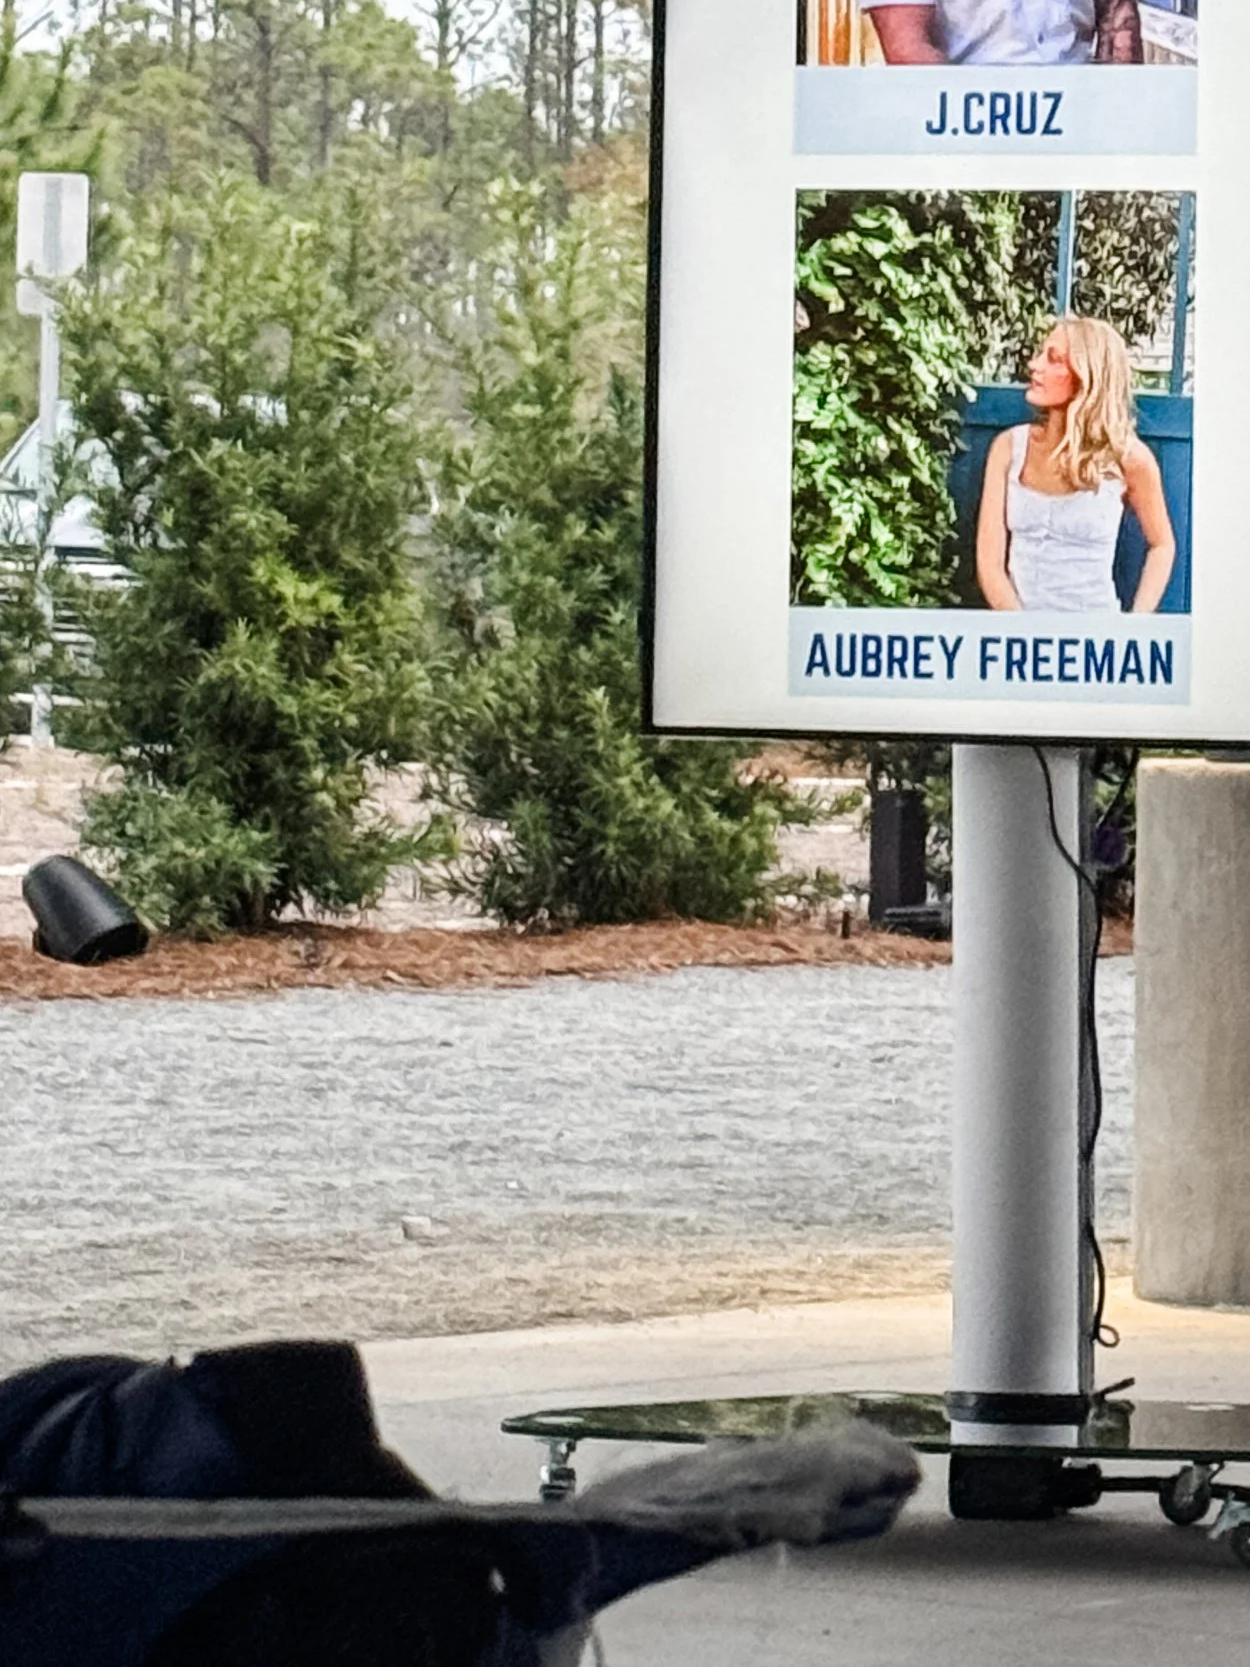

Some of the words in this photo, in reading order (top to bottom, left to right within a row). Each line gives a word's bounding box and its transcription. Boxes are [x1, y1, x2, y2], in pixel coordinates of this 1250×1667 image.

[925, 90, 1064, 136] J.CRUZ
[804, 632, 964, 680] AUBREY
[979, 635, 1174, 685] FREEMAN
